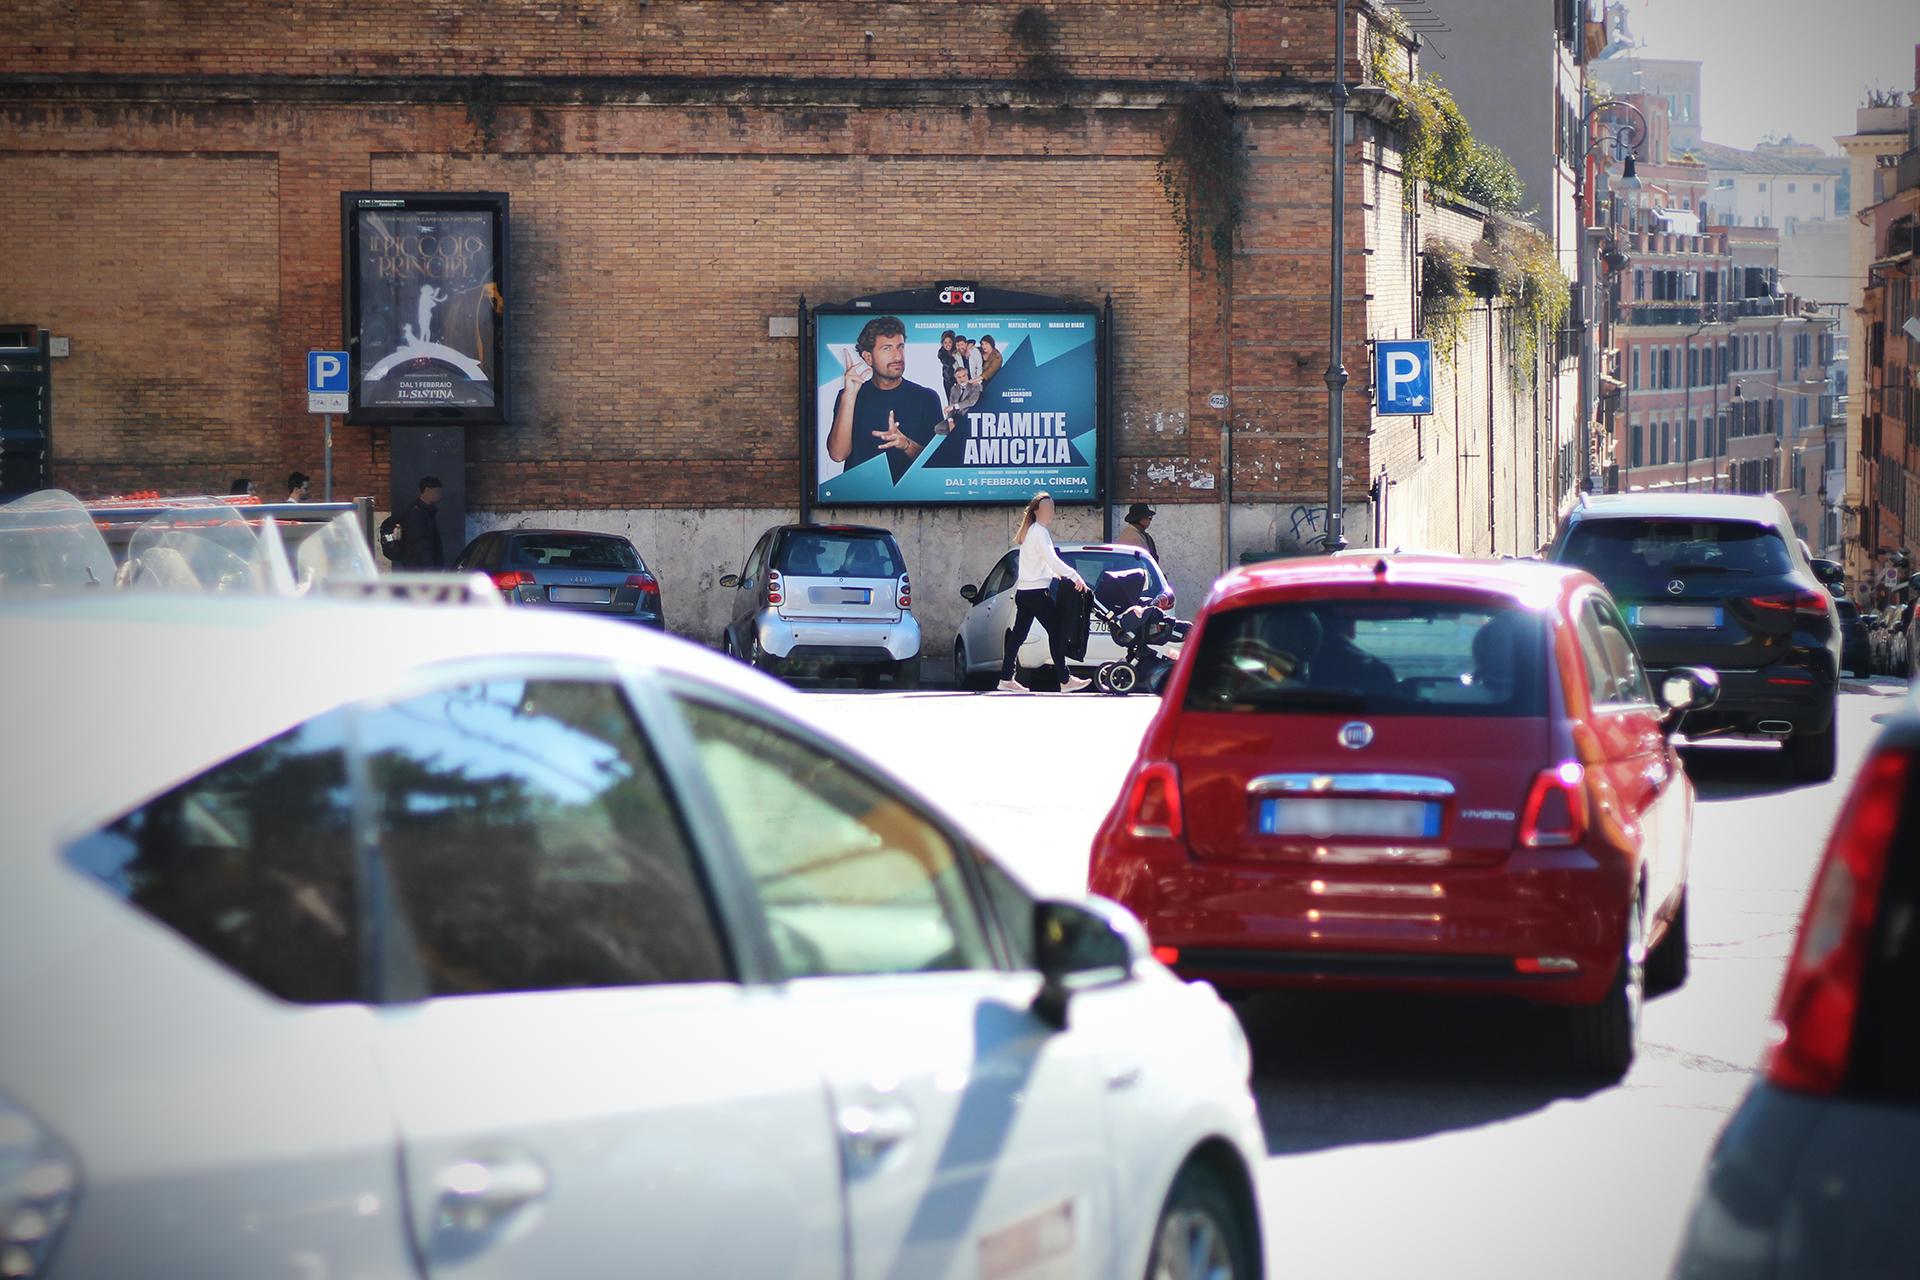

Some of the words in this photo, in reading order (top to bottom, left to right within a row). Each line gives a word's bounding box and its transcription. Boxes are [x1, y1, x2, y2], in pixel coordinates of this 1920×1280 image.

[378, 256, 475, 278] PRINCIPE
[939, 291, 975, 306] apa
[316, 355, 341, 388] P
[1387, 351, 1421, 401] P
[398, 389, 409, 398] IL
[409, 389, 455, 399] SISTINA
[419, 381, 452, 389] FEBBRAIO
[967, 412, 1067, 437] TRAMITE
[963, 437, 1072, 464] AMICIZIA
[945, 478, 966, 487] DAL
[967, 478, 978, 487] 14
[980, 477, 1031, 487] FEBBRAIO
[1033, 477, 1047, 486] AL
[1048, 477, 1088, 486] CINEMA
[1461, 808, 1516, 821] HYBRID
